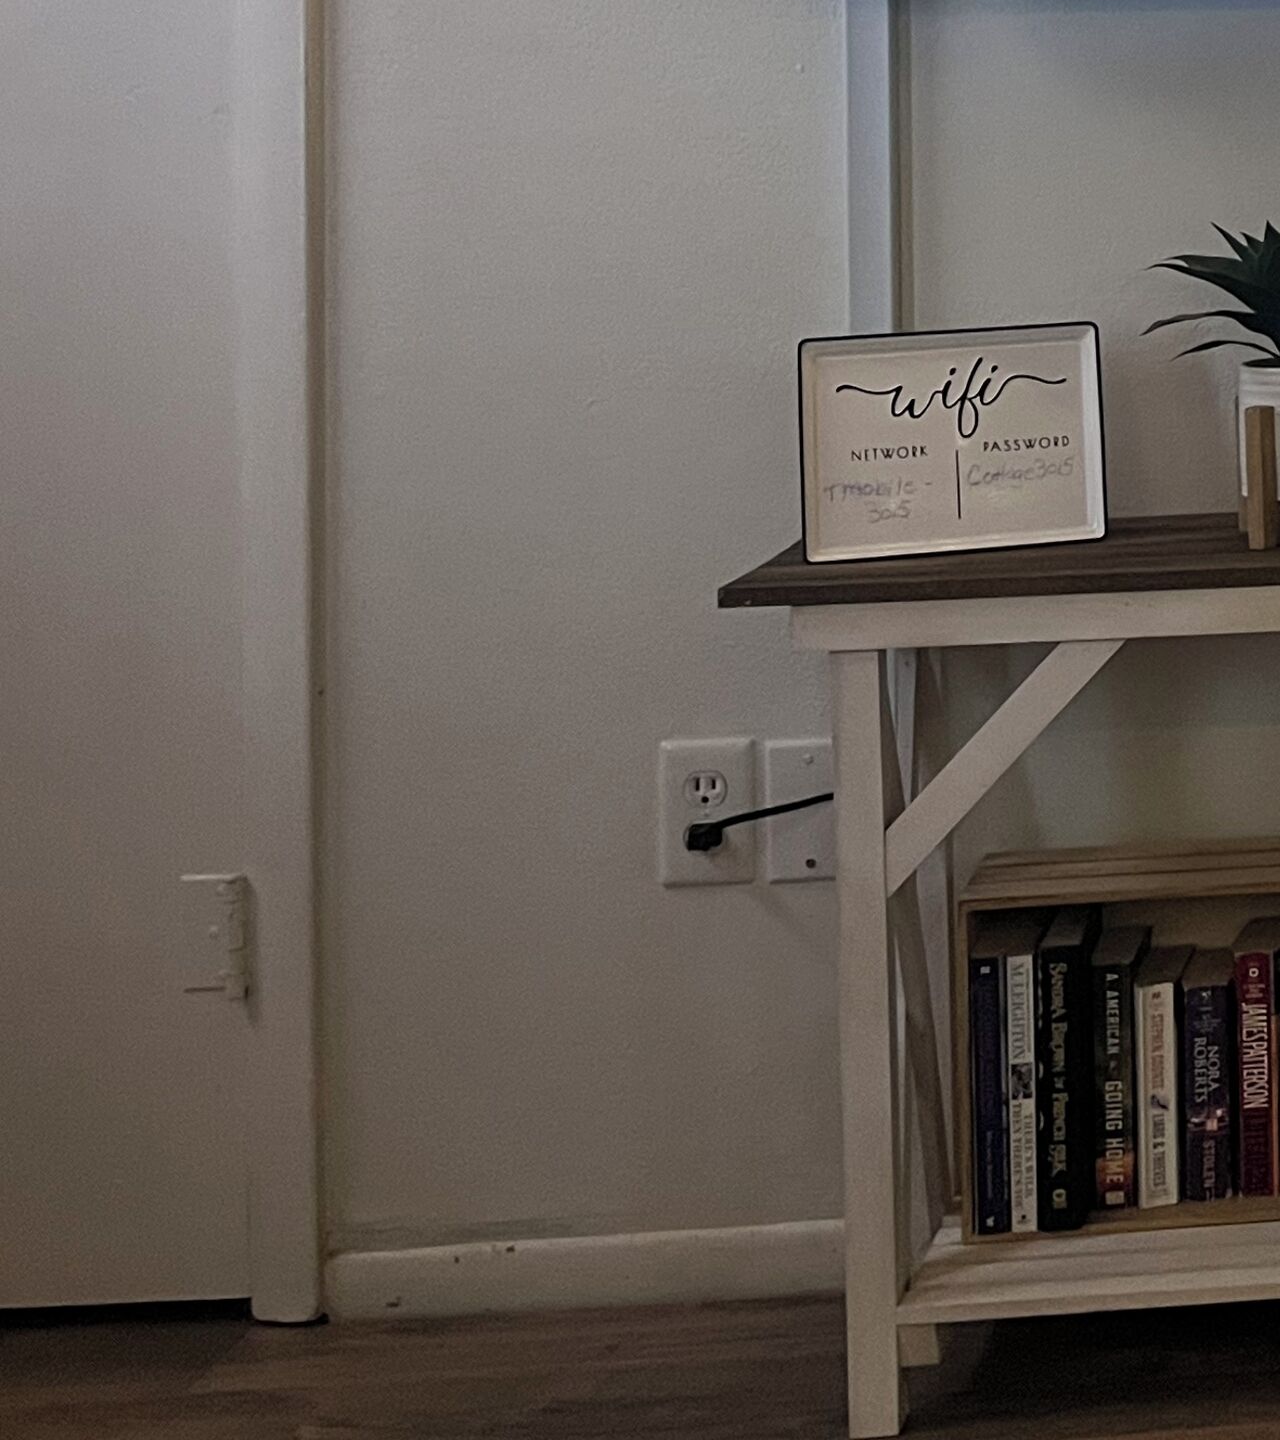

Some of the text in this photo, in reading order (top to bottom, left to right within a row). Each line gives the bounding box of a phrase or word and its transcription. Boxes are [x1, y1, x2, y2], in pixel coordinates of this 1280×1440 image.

[851, 445, 929, 462] NETWORK
[983, 436, 1070, 453] PASSWORD
[1106, 990, 1119, 1054] AMERICAN
[1194, 1036, 1208, 1103] ROBERTS
[1207, 1045, 1221, 1091] NORA
[1105, 1080, 1124, 1183] GOING HOME
